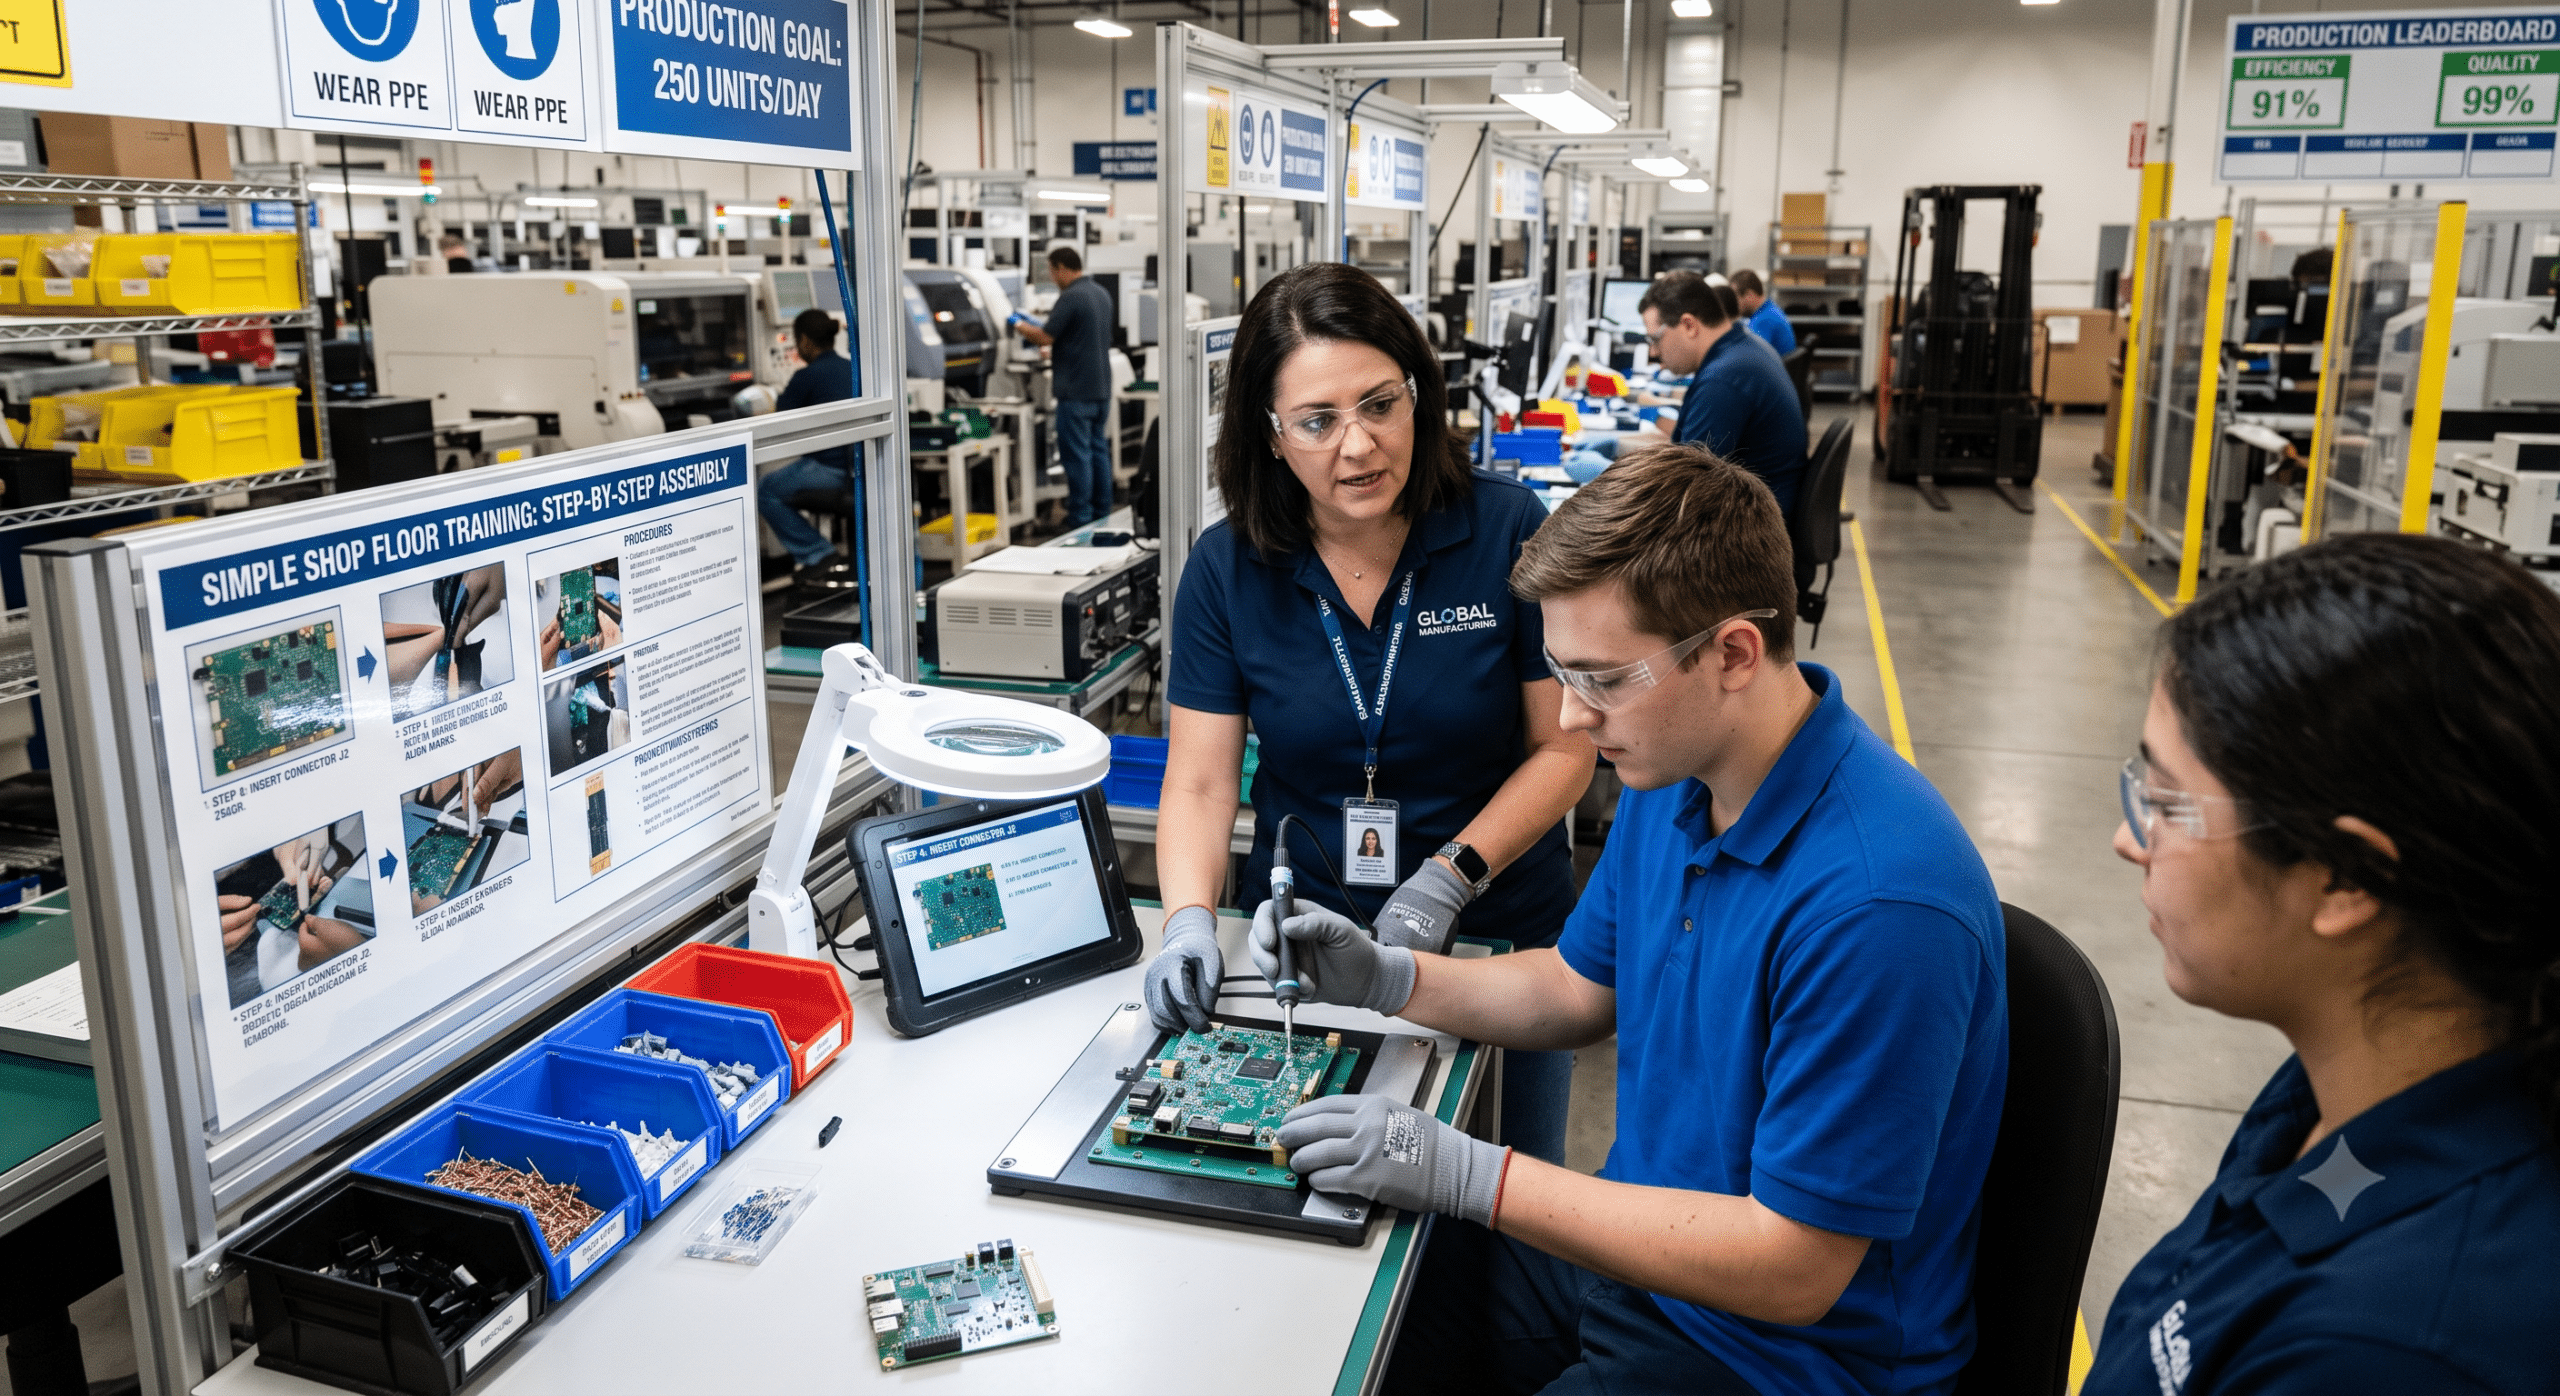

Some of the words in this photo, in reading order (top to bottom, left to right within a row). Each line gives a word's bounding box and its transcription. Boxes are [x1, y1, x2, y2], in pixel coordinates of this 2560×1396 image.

[620, 0, 777, 55] PRODUCTION
[782, 19, 842, 67] GOAL:
[2251, 22, 2390, 48] PRODUCTION
[2394, 19, 2557, 44] LEADERBOARD
[2244, 58, 2337, 77] EFFICIENCY
[2467, 53, 2541, 73] QUALITY
[314, 71, 382, 107] WEAR
[389, 80, 429, 111] PPE
[653, 57, 699, 104] 250
[706, 65, 822, 119] UNITS/DAY
[2252, 88, 2321, 119] 91%
[2462, 83, 2536, 116] 99%
[474, 89, 529, 121] WEAR
[535, 97, 568, 124] PPE
[201, 553, 299, 607] SIMPLE
[303, 540, 366, 582] SHOP
[371, 522, 440, 566] FLOOR
[443, 500, 538, 548] TRAINING:
[542, 473, 655, 524] STEP-BY-STEP
[658, 456, 730, 496] ASSEMBLY
[623, 523, 674, 547] PROCEDURES
[1417, 602, 1495, 627] GLOBAL
[1418, 619, 1497, 637] MANUFACTURING
[402, 721, 421, 737] STEP
[404, 744, 427, 762] ALIGN
[211, 789, 237, 808] STEP
[249, 772, 282, 794] INSERT
[284, 752, 337, 781] CONNECTOR
[338, 748, 350, 761] J2
[896, 849, 918, 864] STEP
[419, 913, 439, 930] STEP
[447, 895, 473, 916] INSERT
[240, 1002, 263, 1022] STEP
[274, 980, 306, 1004] INSERT
[307, 953, 358, 987] CONNECTOR
